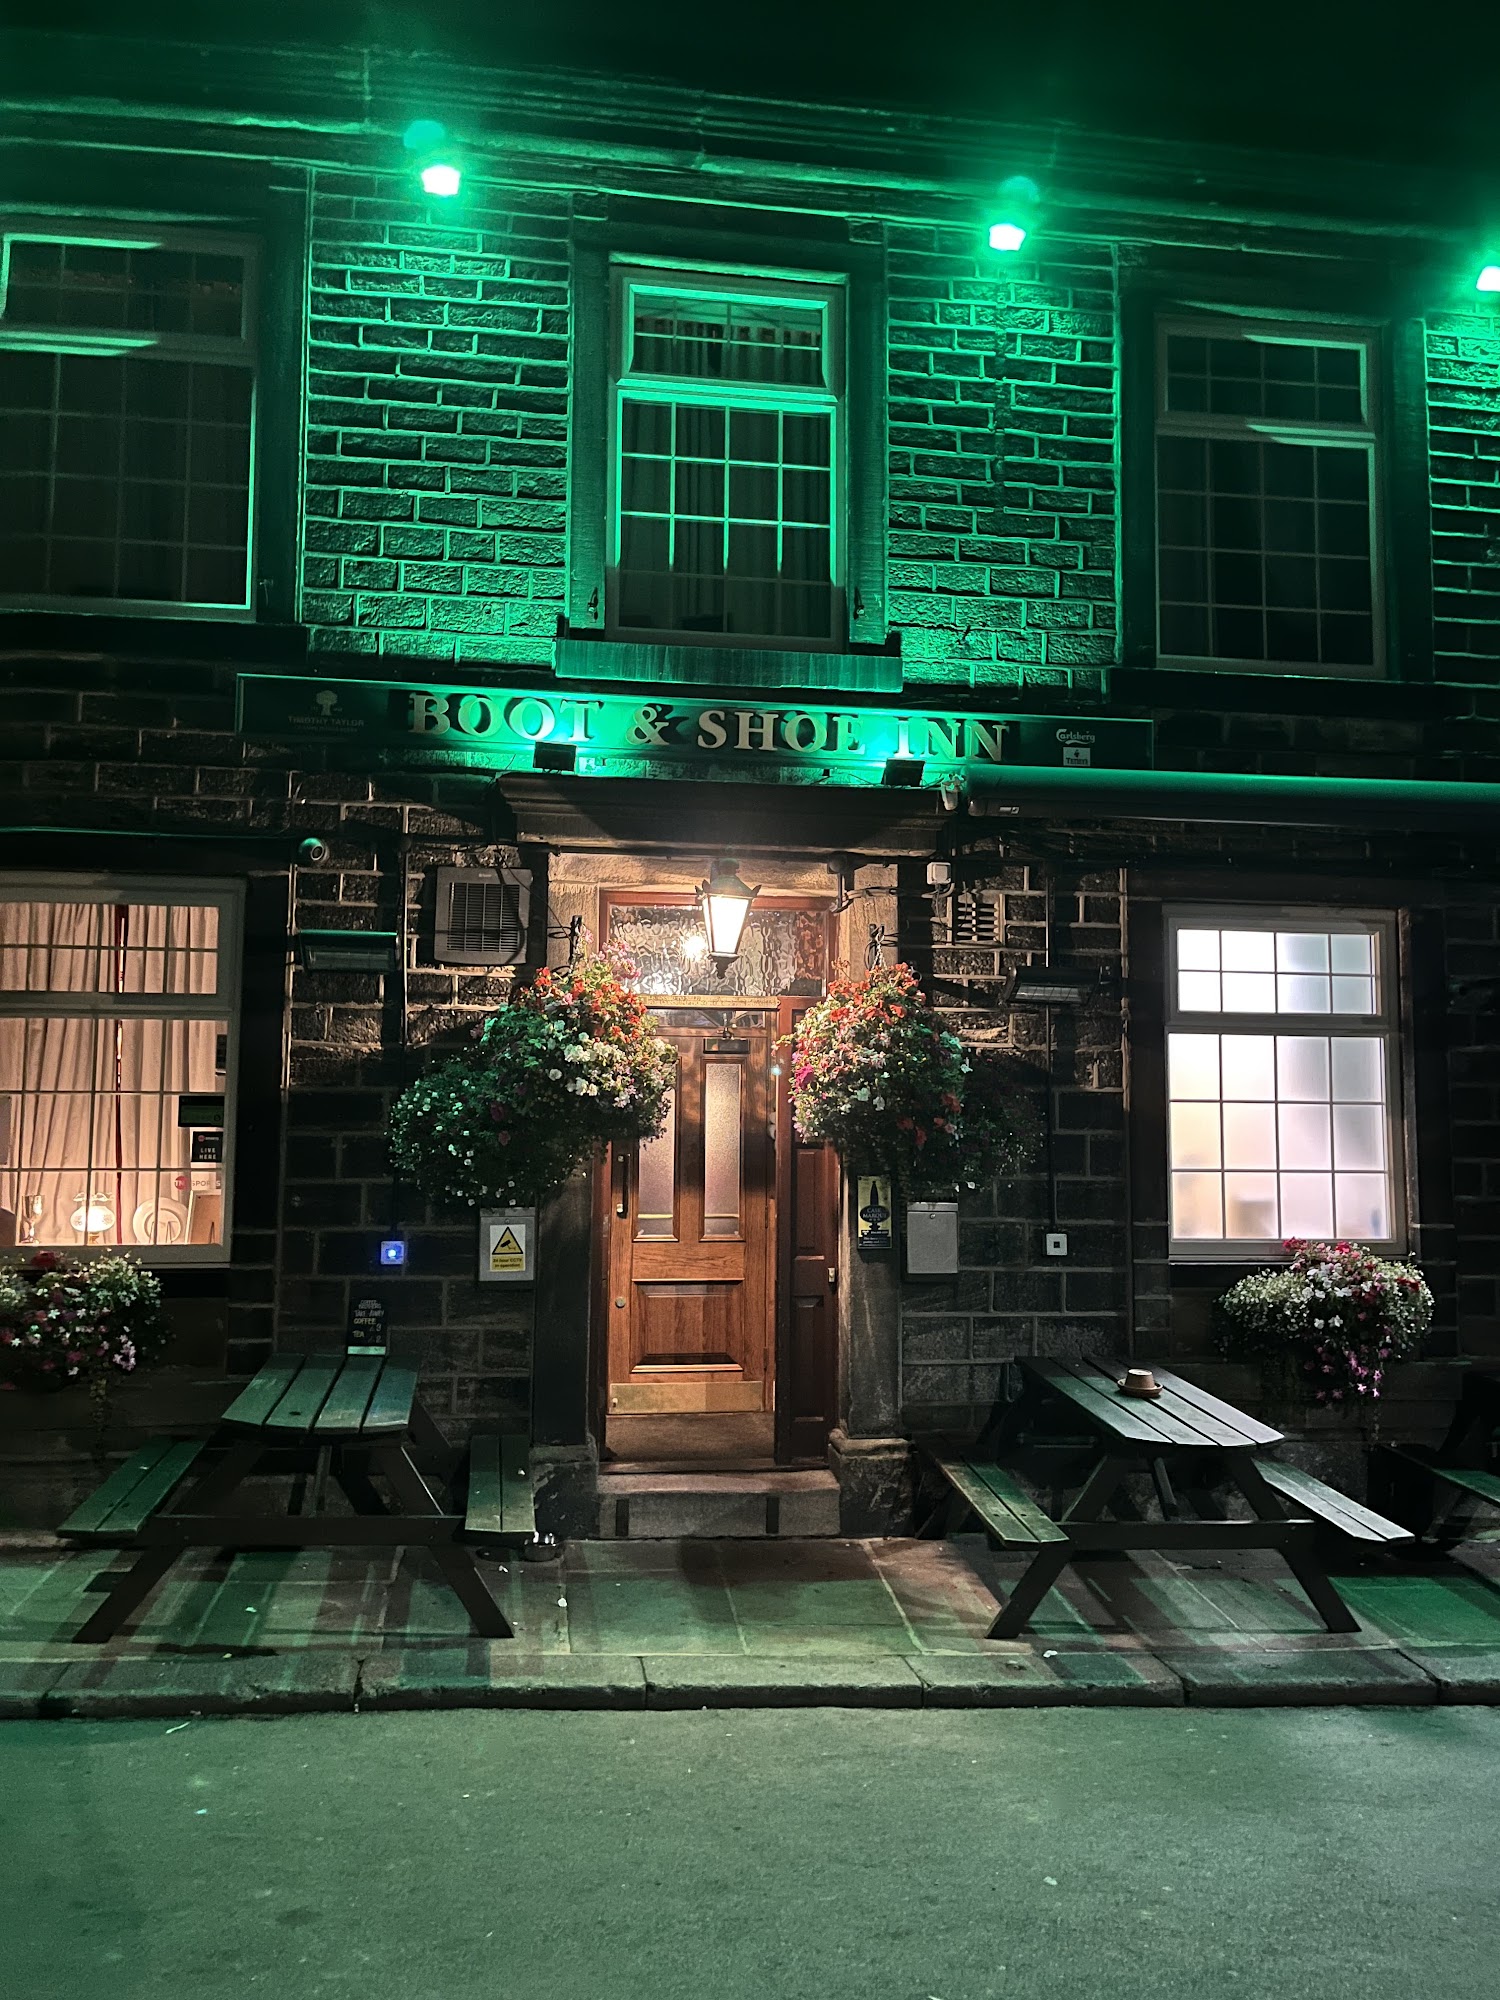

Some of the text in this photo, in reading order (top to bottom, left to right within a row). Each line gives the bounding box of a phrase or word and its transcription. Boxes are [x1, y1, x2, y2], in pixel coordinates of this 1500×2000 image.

[331, 718, 365, 727] TAYLOR
[408, 692, 1009, 762] BOOT & SHOE INN
[1055, 728, 1096, 745] Carlsberg
[353, 1317, 377, 1325] COFFEE
[352, 1330, 365, 1338] TEA
